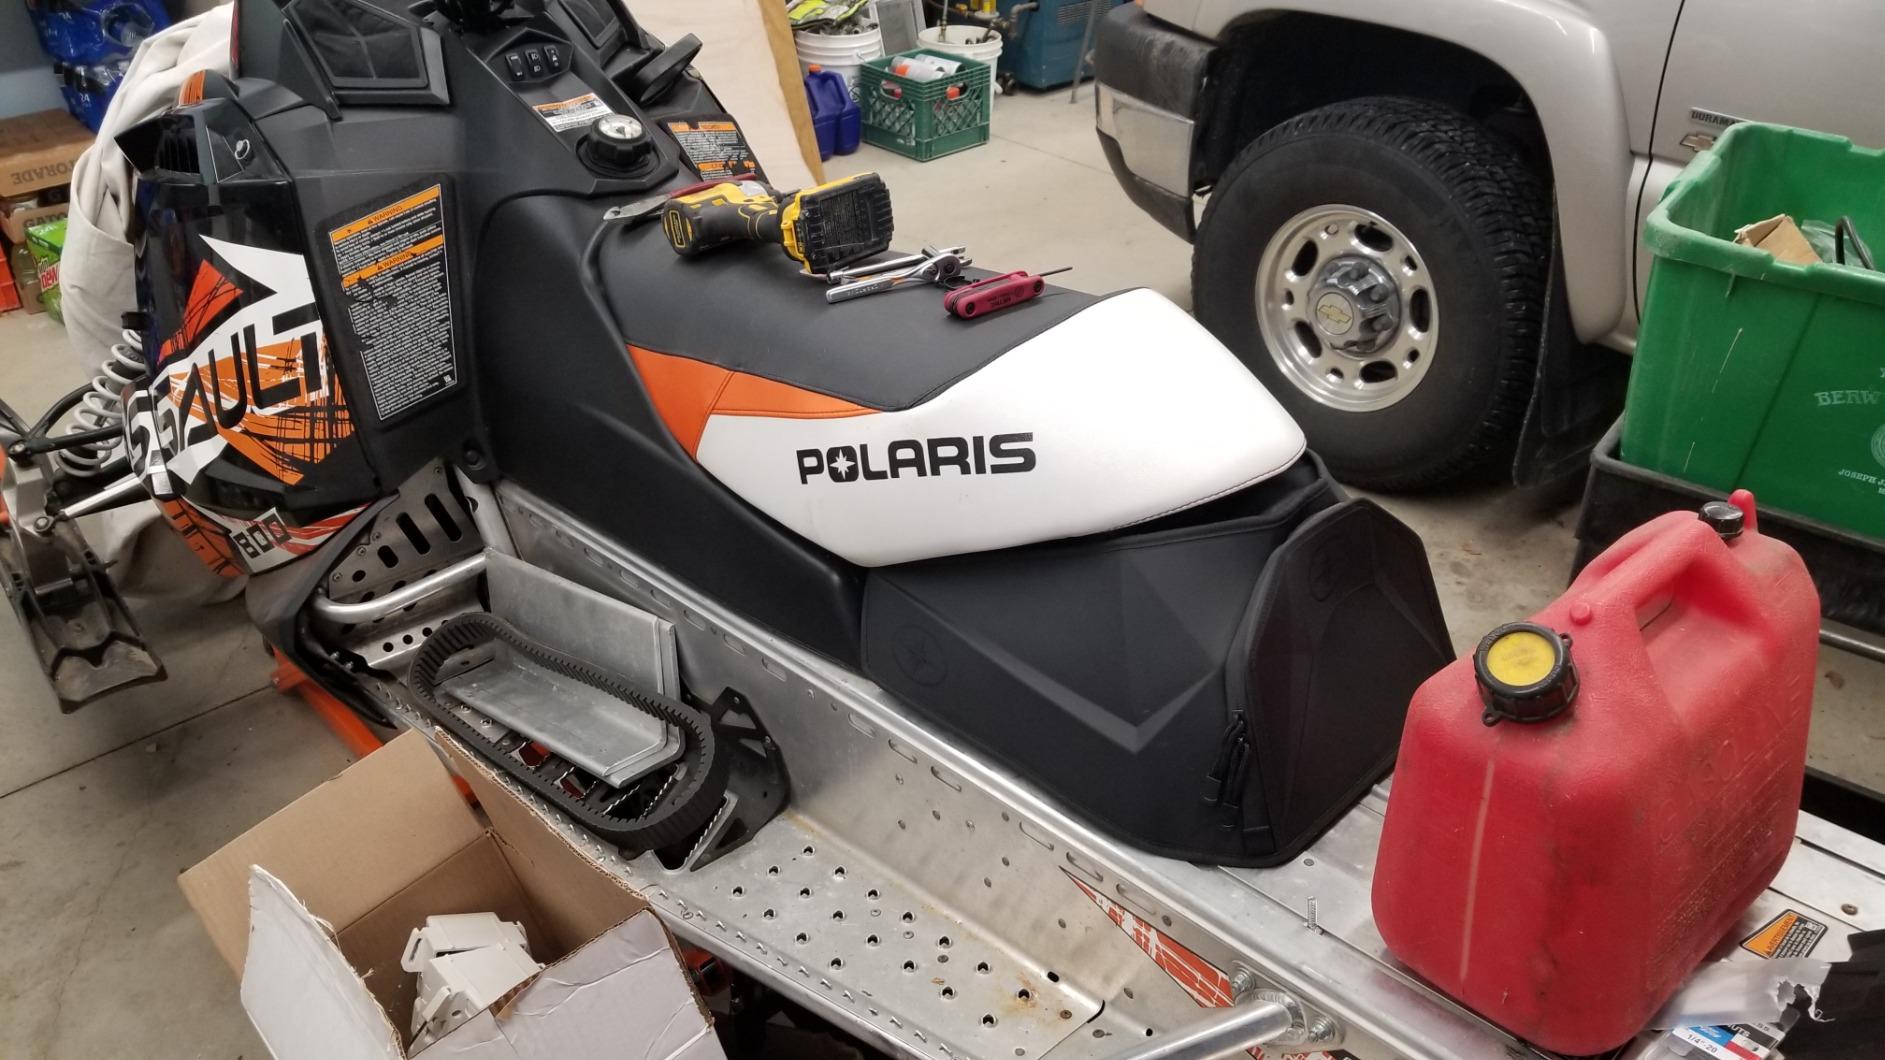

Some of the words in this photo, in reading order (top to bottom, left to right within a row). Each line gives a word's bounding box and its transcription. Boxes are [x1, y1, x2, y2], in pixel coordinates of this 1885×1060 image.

[372, 205, 403, 221] WARNING
[796, 431, 1037, 485] POLARIS
[1838, 468, 1878, 484] JOSEPH
[232, 512, 292, 559] 800
